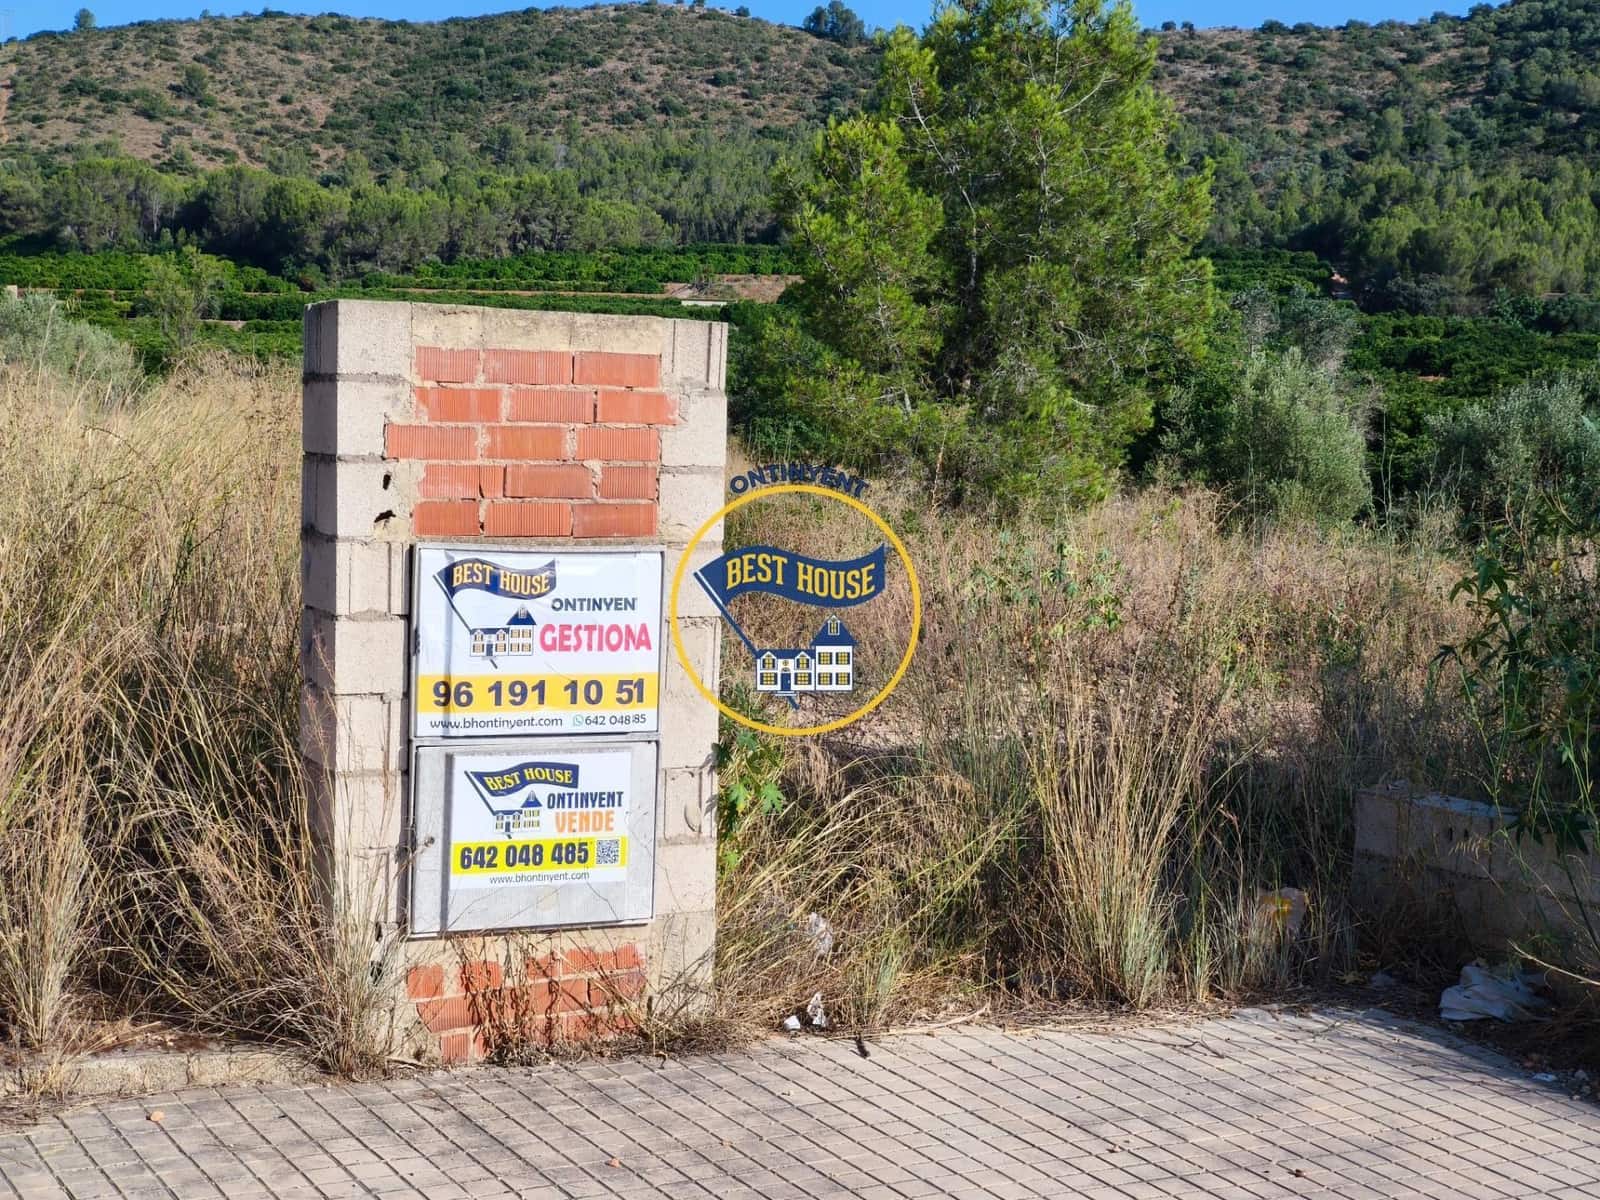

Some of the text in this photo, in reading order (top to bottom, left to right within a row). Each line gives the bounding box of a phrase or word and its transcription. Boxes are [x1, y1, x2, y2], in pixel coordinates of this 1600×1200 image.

[452, 562, 551, 595] BEST HOUSE
[551, 597, 638, 612] ONTINYEN
[539, 623, 652, 652] GESTIONA
[432, 678, 645, 707] 96 191 10 51
[430, 716, 563, 730] www.bhontinyent.com
[584, 714, 606, 726] 642
[483, 768, 574, 791] BEST HOUSE
[555, 810, 615, 833] VENDE
[460, 841, 589, 869] 642 048 485
[489, 871, 590, 884] www.bhontinyent.com
